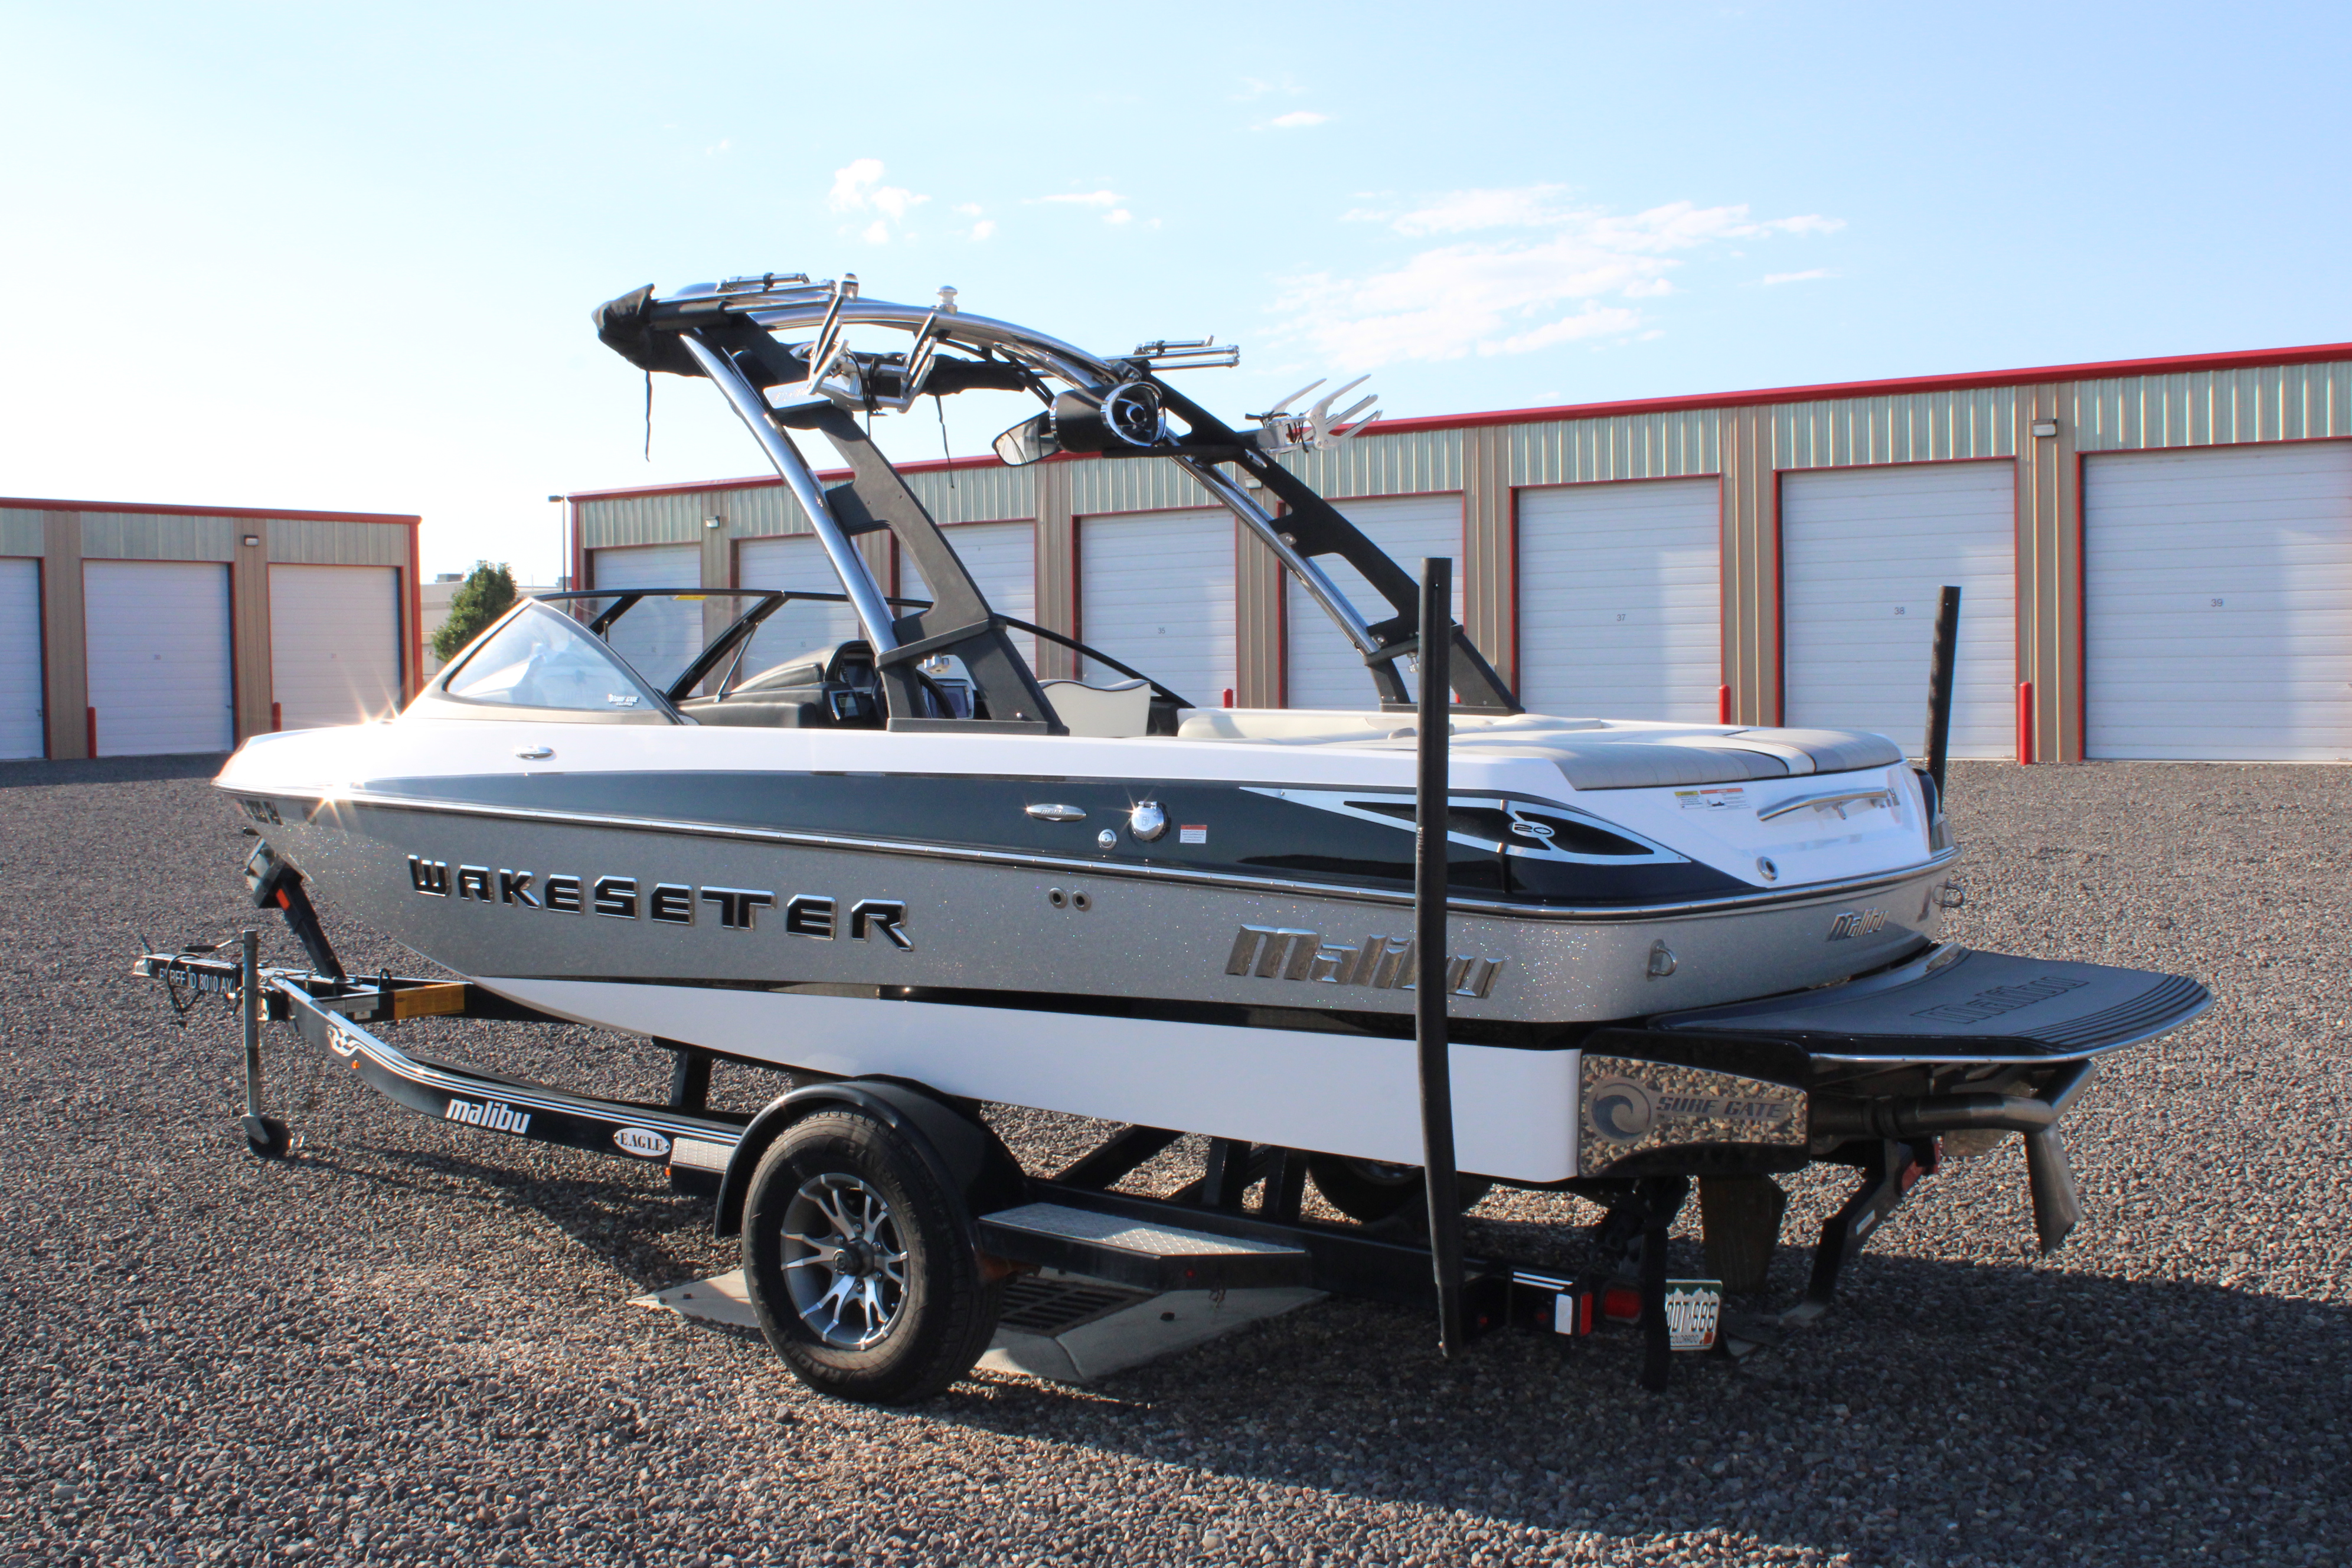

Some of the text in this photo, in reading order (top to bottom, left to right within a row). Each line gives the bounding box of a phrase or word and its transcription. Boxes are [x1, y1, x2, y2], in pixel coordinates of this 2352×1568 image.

[2211, 598, 2223, 607] 39
[1616, 613, 1626, 622] 37
[1894, 607, 1905, 615] 38
[1514, 824, 1551, 834] 20
[407, 854, 914, 952] WAKESETTER
[1656, 1096, 1785, 1118] SURF GATE
[445, 1099, 531, 1134] malibu
[620, 1132, 663, 1152] EAGLE
